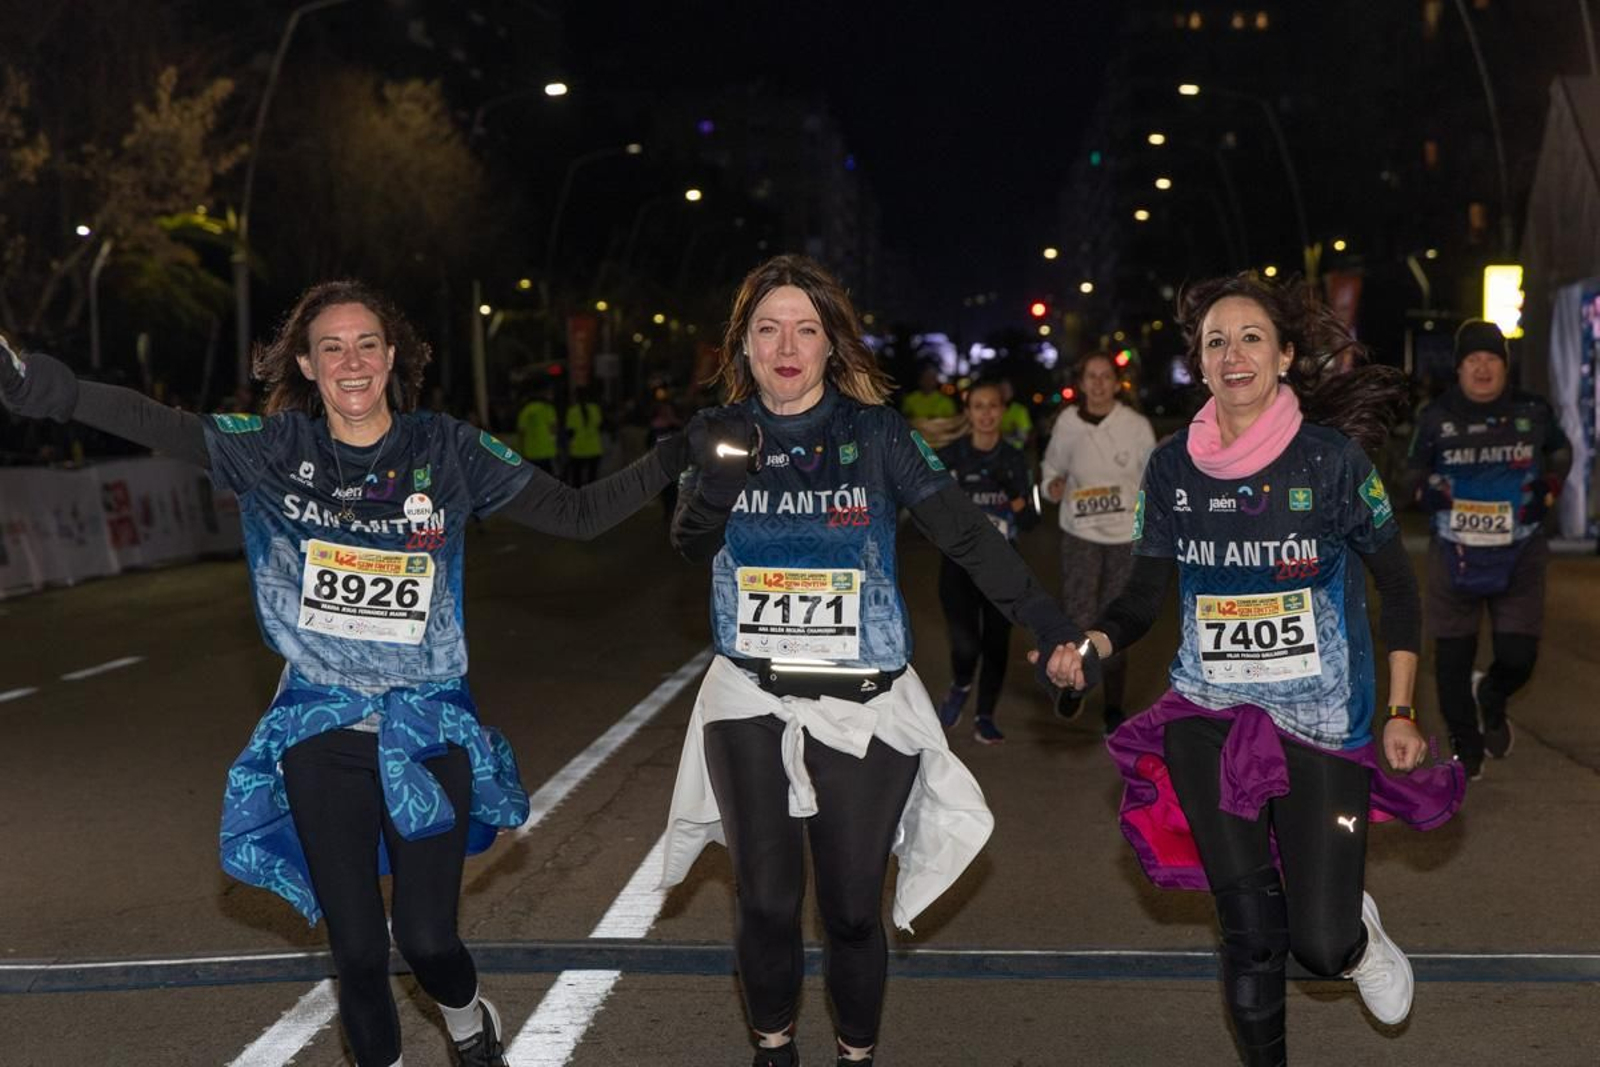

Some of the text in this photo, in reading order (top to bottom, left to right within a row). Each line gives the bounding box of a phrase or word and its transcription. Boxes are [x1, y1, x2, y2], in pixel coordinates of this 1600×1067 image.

[1443, 447, 1475, 464] SAN
[731, 483, 869, 514] AN ANTÓN
[1076, 494, 1121, 512] 6900
[283, 494, 341, 528] SAN
[828, 506, 872, 527] 2025
[1456, 513, 1507, 530] 9092
[334, 551, 358, 567] 42
[1224, 533, 1318, 567] ANTÓN
[1275, 556, 1323, 580] 2025
[314, 569, 420, 608] 8926
[763, 572, 784, 588] 42
[748, 593, 843, 625] 7171
[1216, 600, 1238, 616] 42
[1205, 615, 1305, 650] 7405
